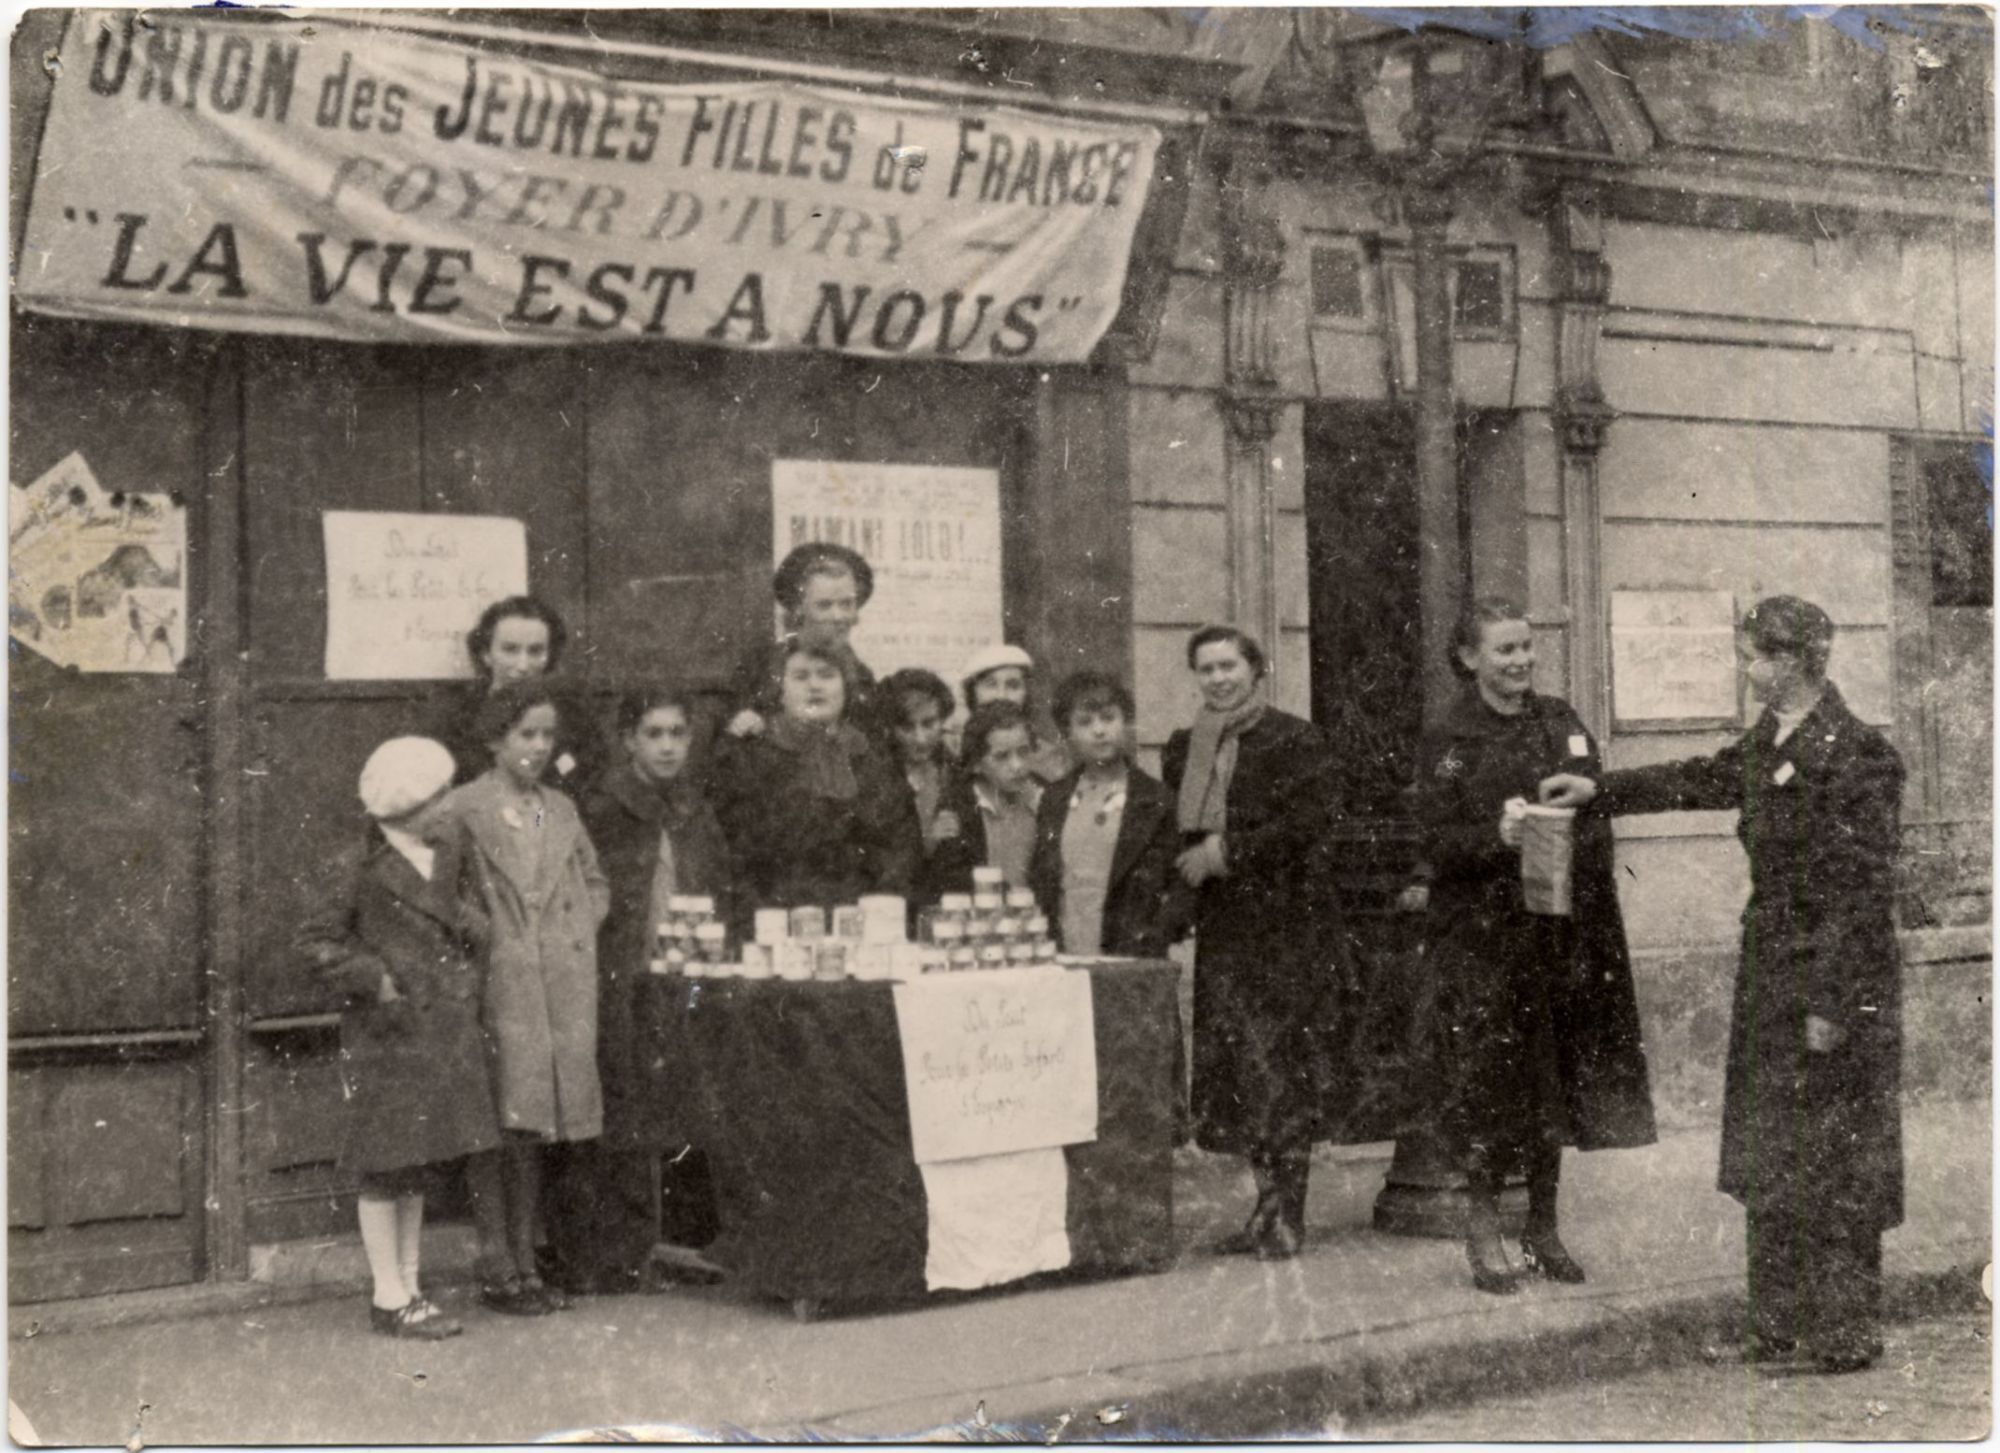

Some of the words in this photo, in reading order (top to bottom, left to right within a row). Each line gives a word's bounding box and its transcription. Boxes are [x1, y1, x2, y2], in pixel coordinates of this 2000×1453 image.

[88, 12, 298, 124] UNION
[315, 52, 408, 134] des
[435, 57, 665, 163] JEUNES
[681, 95, 856, 183] FILLES
[873, 120, 926, 194] de
[948, 117, 1140, 207] FRANCE
[324, 156, 624, 235] FOYER
[649, 190, 928, 262] D'IVRY
[296, 232, 473, 314] VIE
[503, 254, 697, 334] EST
[705, 272, 771, 343] A
